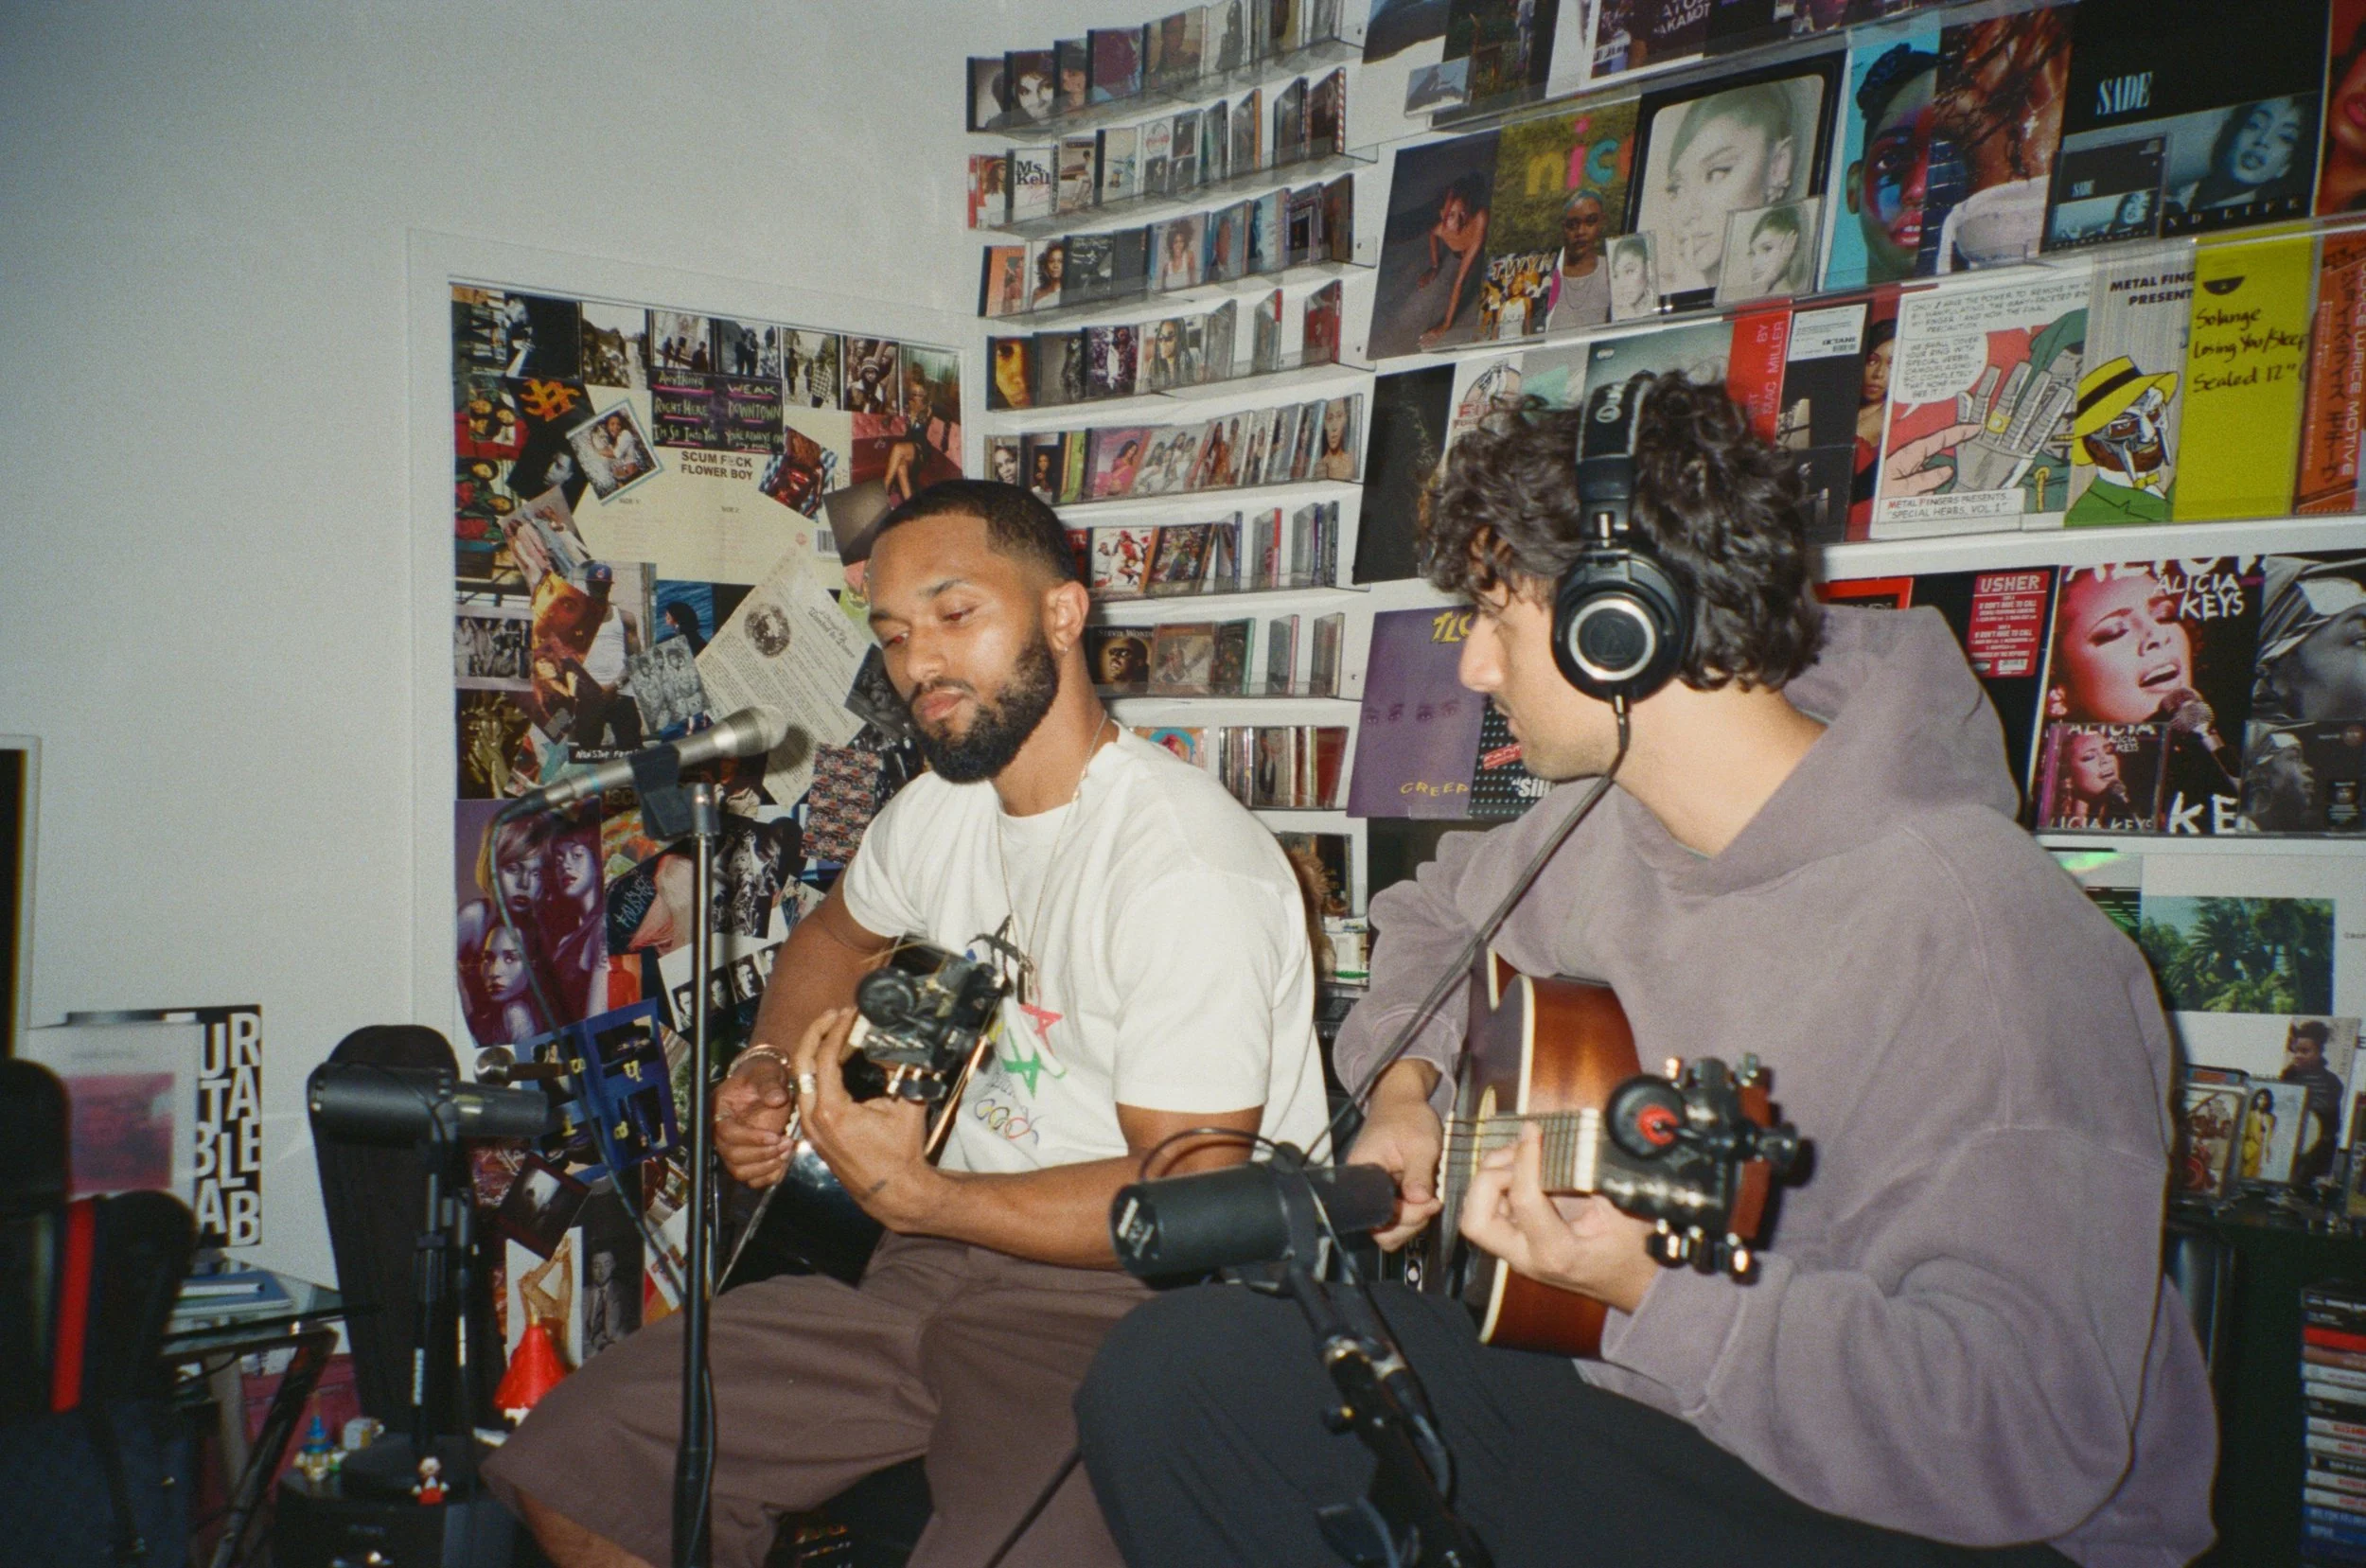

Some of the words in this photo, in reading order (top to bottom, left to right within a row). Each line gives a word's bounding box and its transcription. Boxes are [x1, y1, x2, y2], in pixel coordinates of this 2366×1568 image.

[2095, 71, 2153, 115] SADE
[1015, 160, 1045, 173] Ms.
[2224, 198, 2299, 219] LIFE
[2110, 276, 2158, 291] METAL
[1981, 292, 2013, 302] POWER
[2128, 289, 2194, 306] PRESENT
[1767, 321, 1784, 374] MILLER
[2194, 341, 2237, 363] Losing
[2349, 330, 2365, 395] WRICE
[2194, 366, 2258, 393] Sealed
[727, 383, 777, 395] WEAK
[2341, 401, 2359, 476] MOTIVE
[681, 450, 717, 464] SCUM
[720, 454, 752, 467] FCK
[680, 464, 729, 478] FLOWER
[731, 468, 753, 480] BOY
[1887, 499, 1917, 509] METAL
[1919, 494, 1961, 506] FINGERS
[1981, 575, 2040, 593] USHER
[2155, 573, 2239, 594] ALICIA
[2179, 590, 2245, 621] KEYS
[2115, 743, 2141, 753] KEYS
